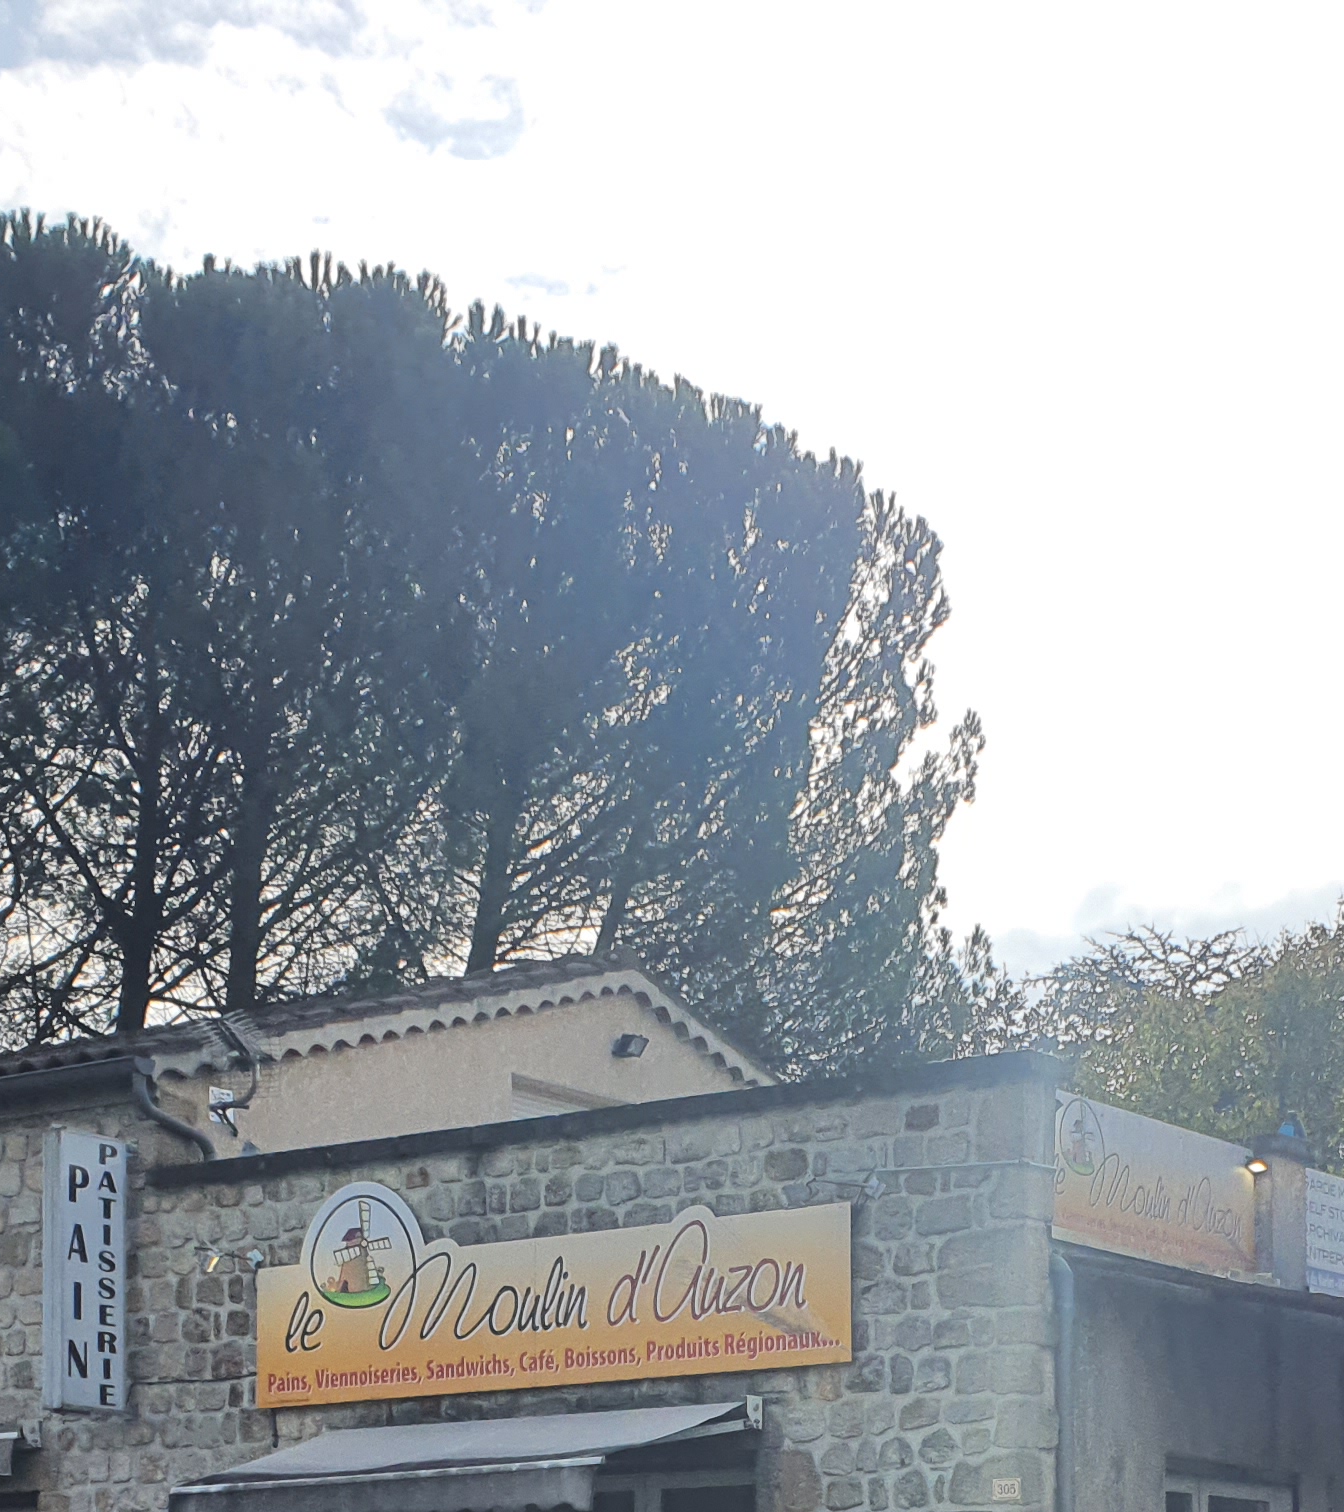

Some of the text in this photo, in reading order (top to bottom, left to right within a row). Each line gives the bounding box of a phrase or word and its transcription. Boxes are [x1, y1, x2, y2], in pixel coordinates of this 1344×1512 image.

[1090, 1153, 1171, 1223] Moulin
[67, 1163, 90, 1379] PAIN
[97, 1143, 117, 1407] PATISSERIE
[285, 1219, 806, 1352] le Moulin d'Auzon
[267, 1371, 312, 1394] Pains,
[315, 1361, 424, 1390] Viennoiseries,
[426, 1353, 516, 1381] Sandwichs,
[519, 1348, 560, 1374] Café,
[564, 1345, 642, 1371] Boissons,
[646, 1335, 720, 1361] Produits
[997, 1483, 1016, 1495] 305
